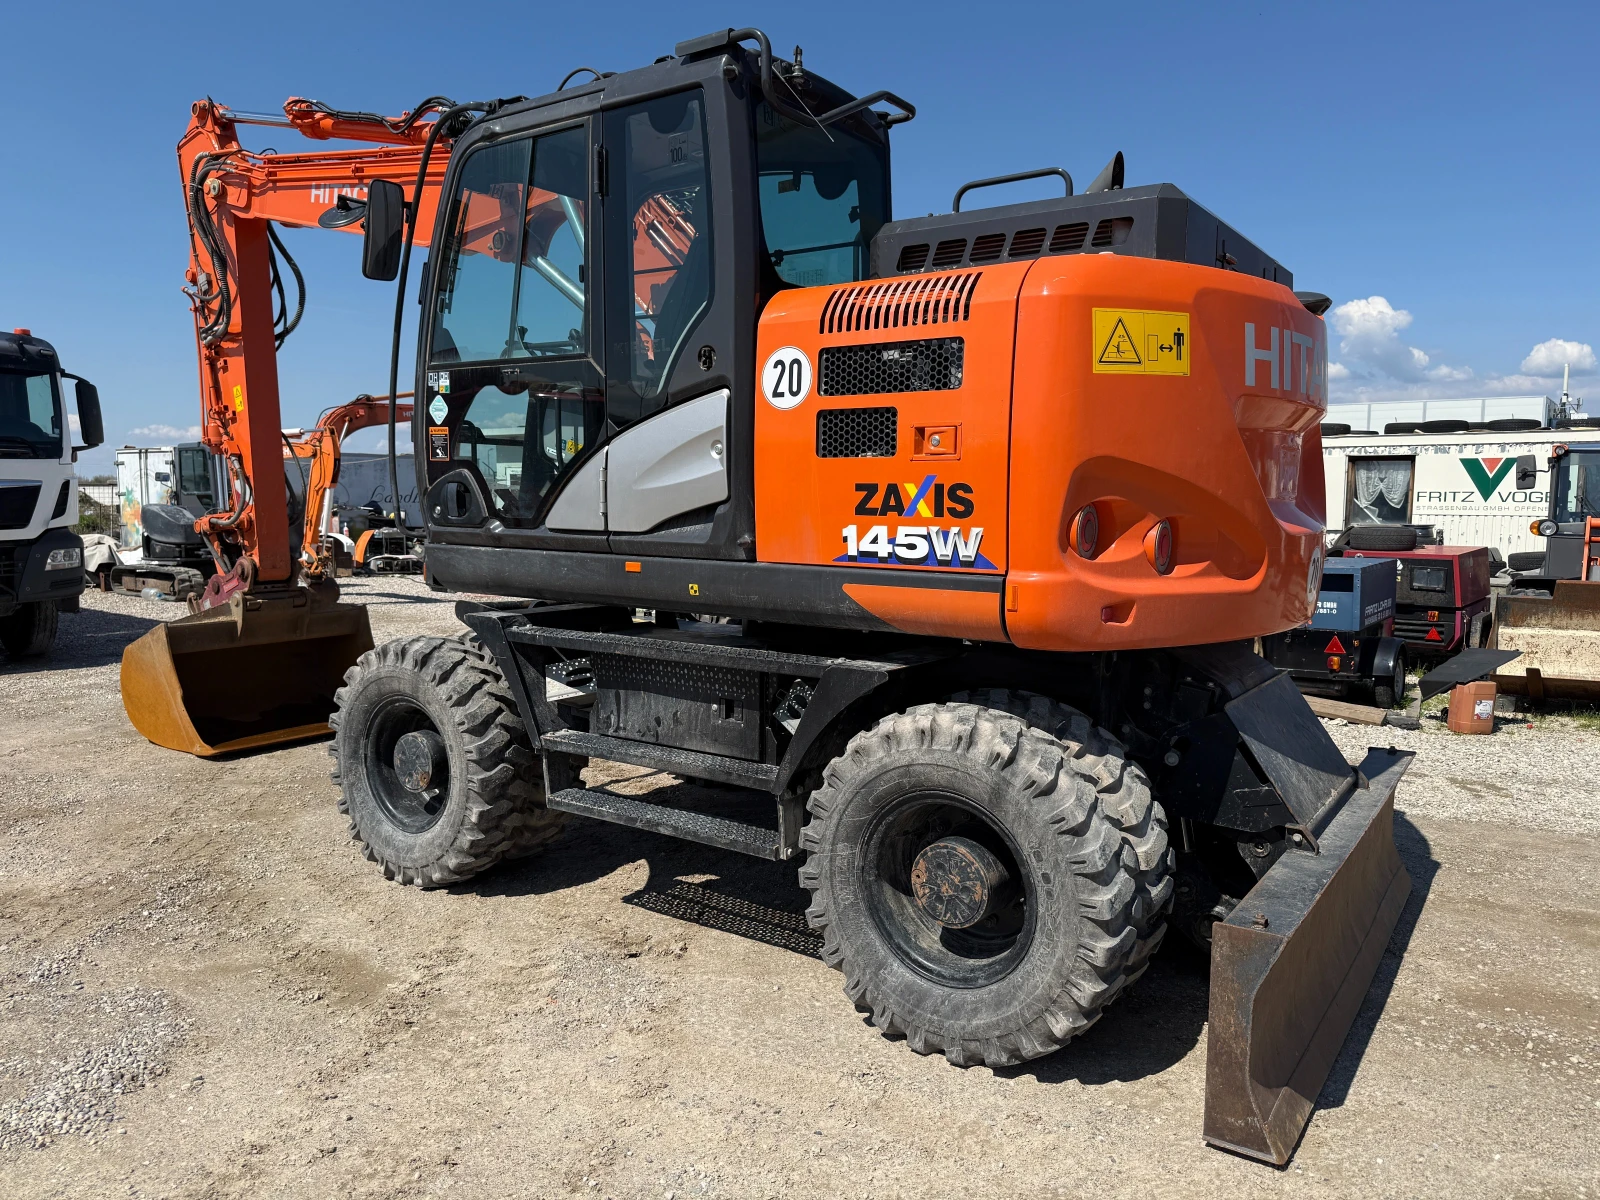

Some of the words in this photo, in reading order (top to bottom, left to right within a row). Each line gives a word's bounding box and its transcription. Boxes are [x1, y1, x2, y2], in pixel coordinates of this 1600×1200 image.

[670, 146, 683, 164] 100
[772, 358, 802, 398] 20
[854, 475, 975, 519] ZAXIS
[1416, 491, 1475, 502] FRITZ
[842, 525, 984, 564] 145W
